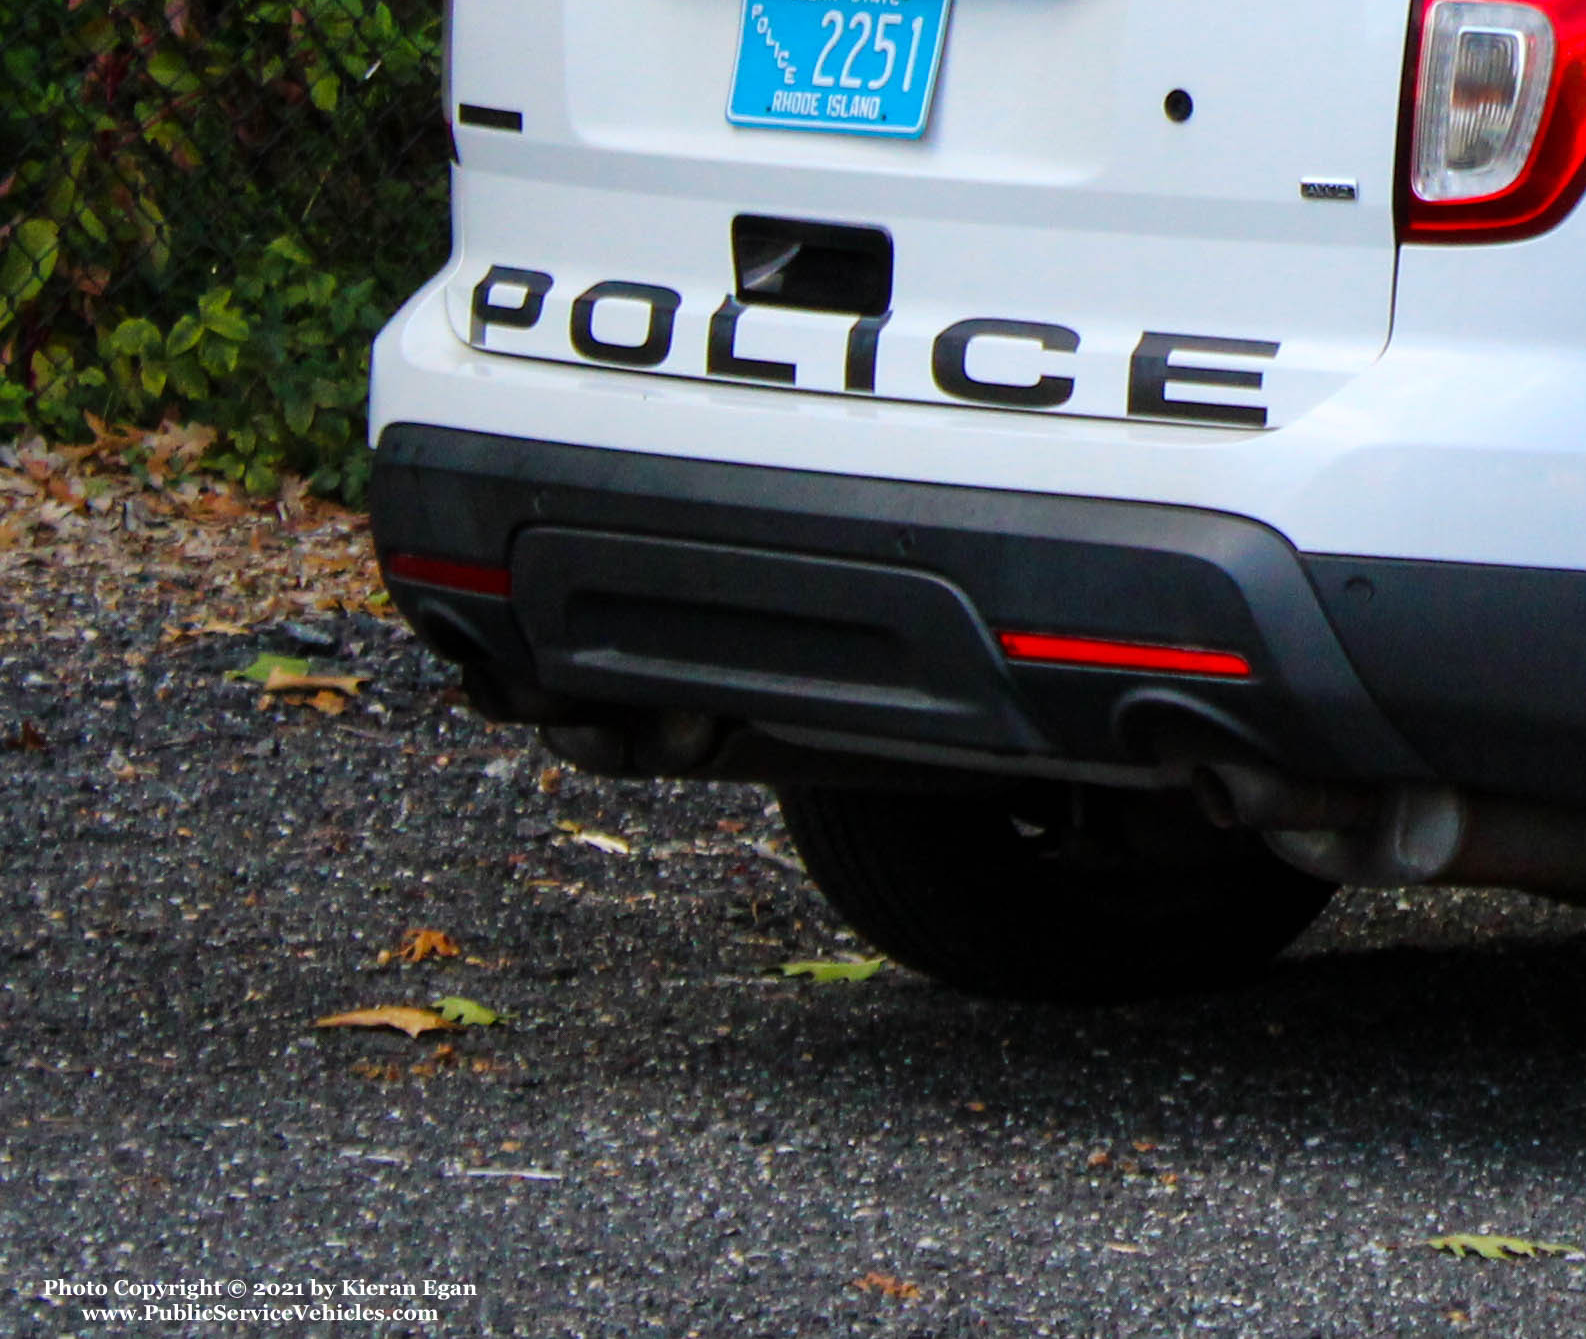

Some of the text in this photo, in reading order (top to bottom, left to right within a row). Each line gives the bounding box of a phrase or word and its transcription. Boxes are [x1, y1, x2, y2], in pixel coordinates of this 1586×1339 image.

[751, 3, 797, 85] POLICE
[811, 9, 924, 93] 2251
[771, 90, 881, 120] RHODE ISLAND
[471, 264, 1282, 427] POLICE
